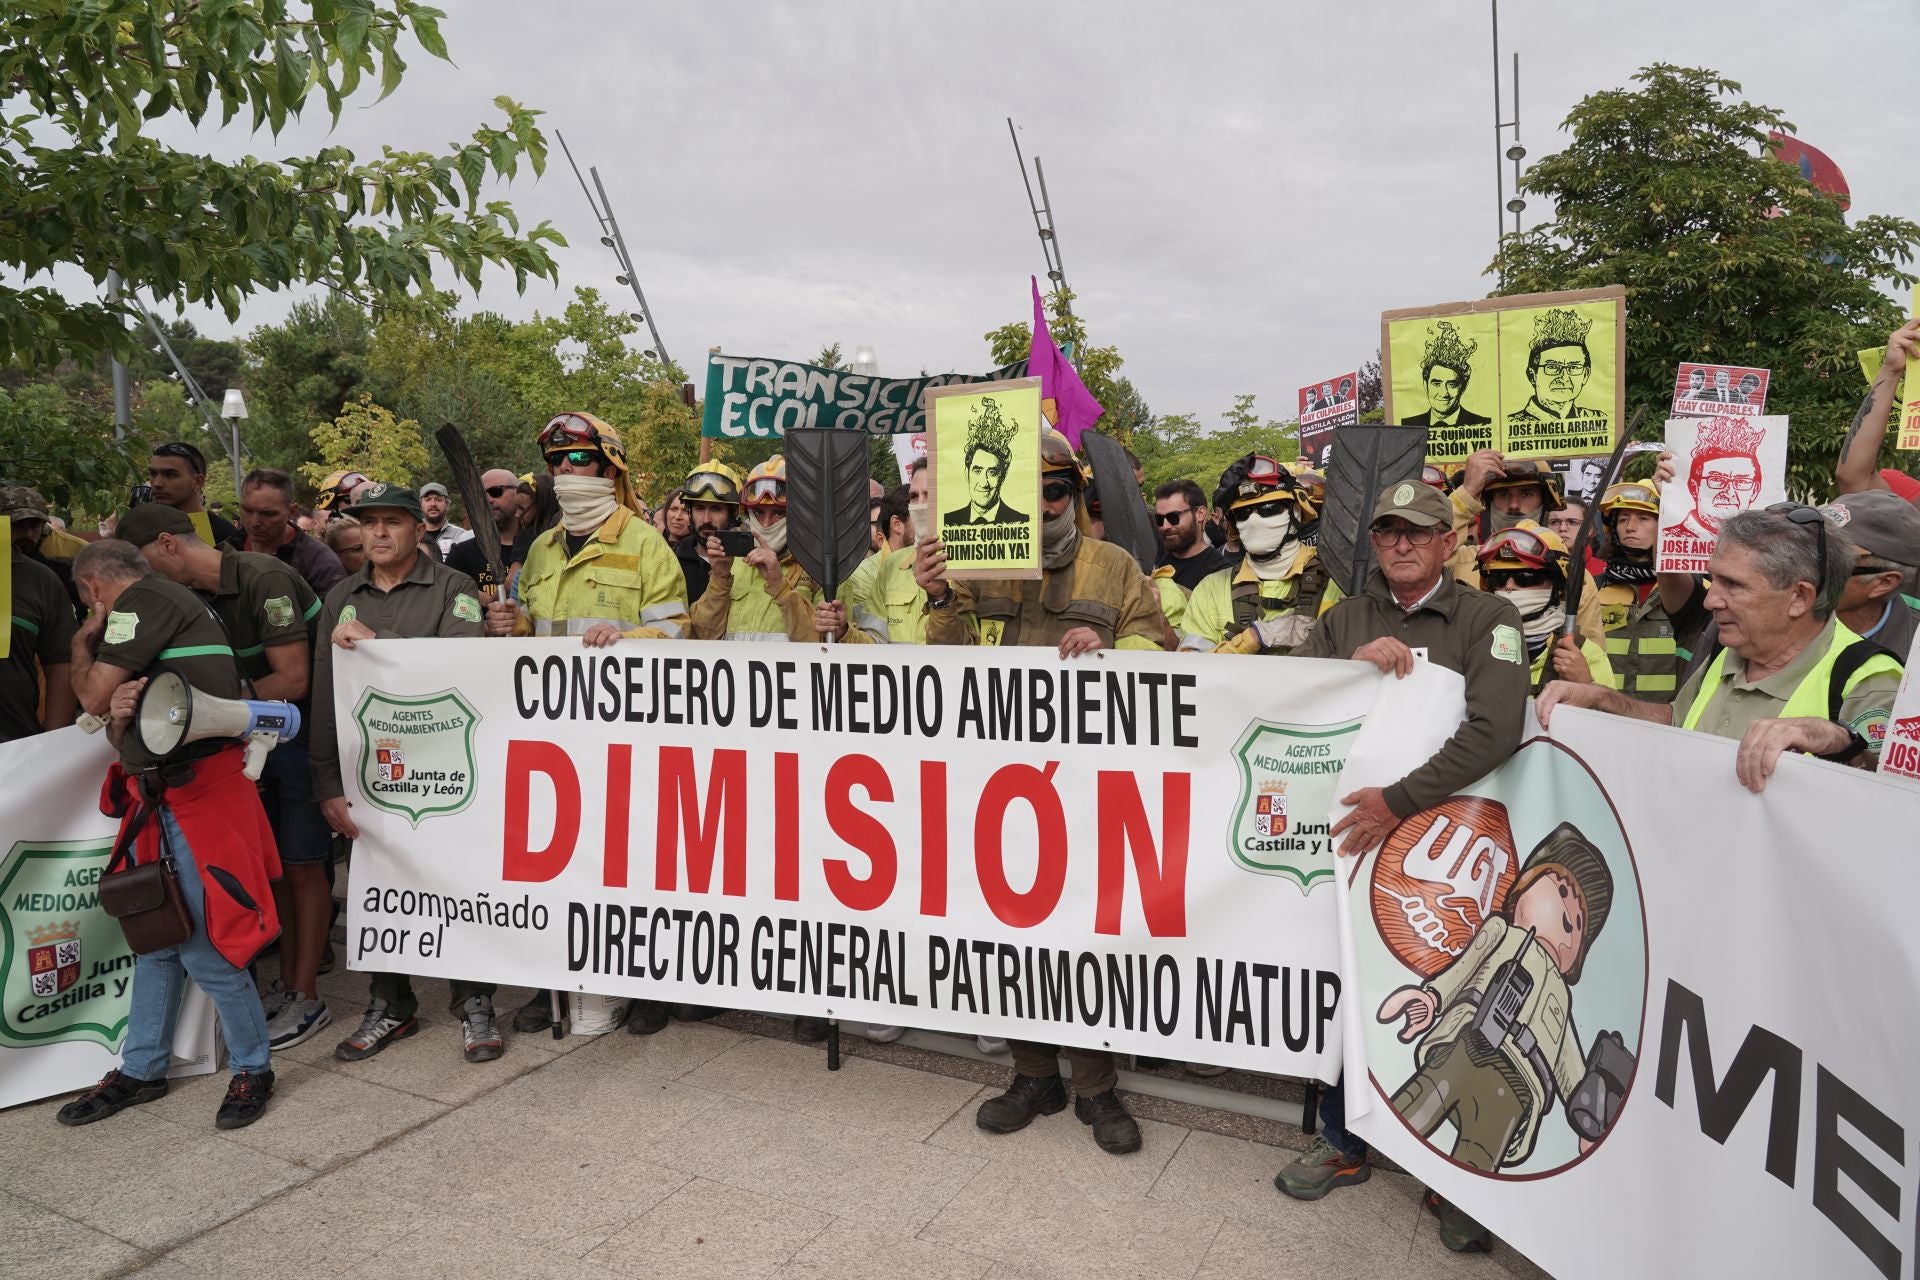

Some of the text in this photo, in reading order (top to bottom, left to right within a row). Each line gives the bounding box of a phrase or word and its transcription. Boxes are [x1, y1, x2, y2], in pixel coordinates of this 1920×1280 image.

[1302, 402, 1354, 423] HAY CULPABLES.
[1678, 401, 1756, 416] HAY CULPABLES.
[1302, 421, 1331, 432] CASTILLA
[1338, 412, 1355, 422] LEÓN
[1509, 422, 1532, 436] JOSÉ
[1534, 421, 1565, 435] ÁNGEL
[1567, 419, 1608, 433] ARRANZ
[1508, 436, 1608, 452] ¡DESTITUCIÓN YA!
[942, 526, 1030, 542] SUAREZ-QUIÑONES
[1008, 543, 1030, 560] YA!
[1662, 539, 1688, 553] JOSÉ
[1660, 559, 1709, 571] ¡DESTIT
[514, 655, 1199, 748] CONSEJERO DE MEDIO AMBIENTE
[392, 710, 433, 722] AGENTES
[369, 716, 464, 735] MEDIOAMBIENTALES
[1285, 744, 1331, 757] AGENTES
[1254, 754, 1346, 775] MEDIOAMBIENTA
[408, 769, 465, 782] Junta de
[372, 781, 463, 796] Castilla y León
[502, 740, 1191, 938] DIMISIÓN
[1245, 837, 1305, 851] Castilla
[1311, 840, 1322, 855] y
[1402, 813, 1510, 921] UGT
[363, 886, 549, 931] acompañado
[358, 924, 444, 960] por el
[567, 901, 740, 987] DIRECTOR
[751, 915, 918, 1007] GENERAL
[928, 934, 1181, 1037] PATRIMONIO
[17, 976, 129, 1024] Castilla y
[1655, 977, 1920, 1280] ME
